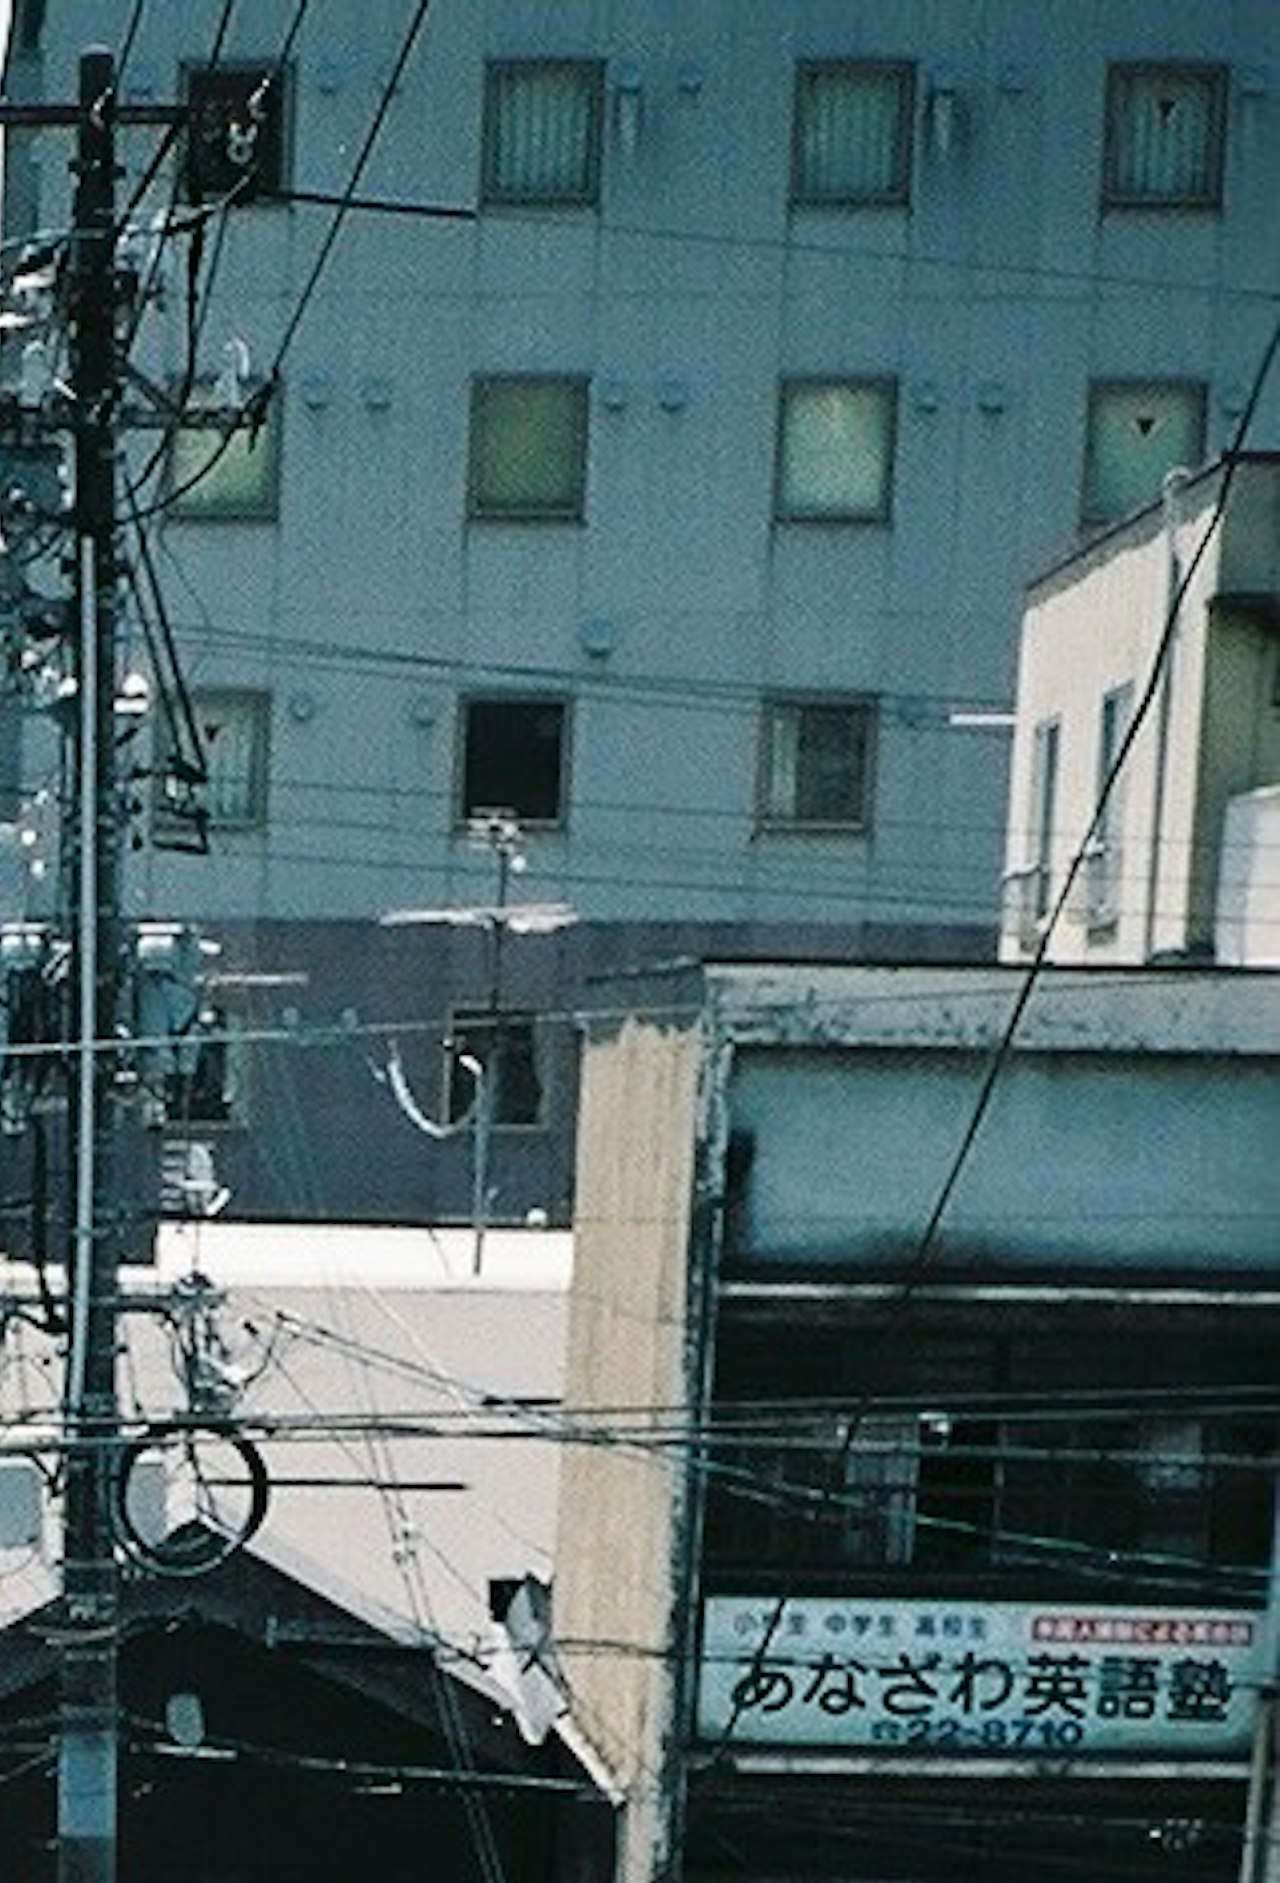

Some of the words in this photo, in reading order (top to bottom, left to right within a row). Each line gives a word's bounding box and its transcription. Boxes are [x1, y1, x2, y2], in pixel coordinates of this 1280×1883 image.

[731, 1652, 1230, 1720] あなざわ英語塾
